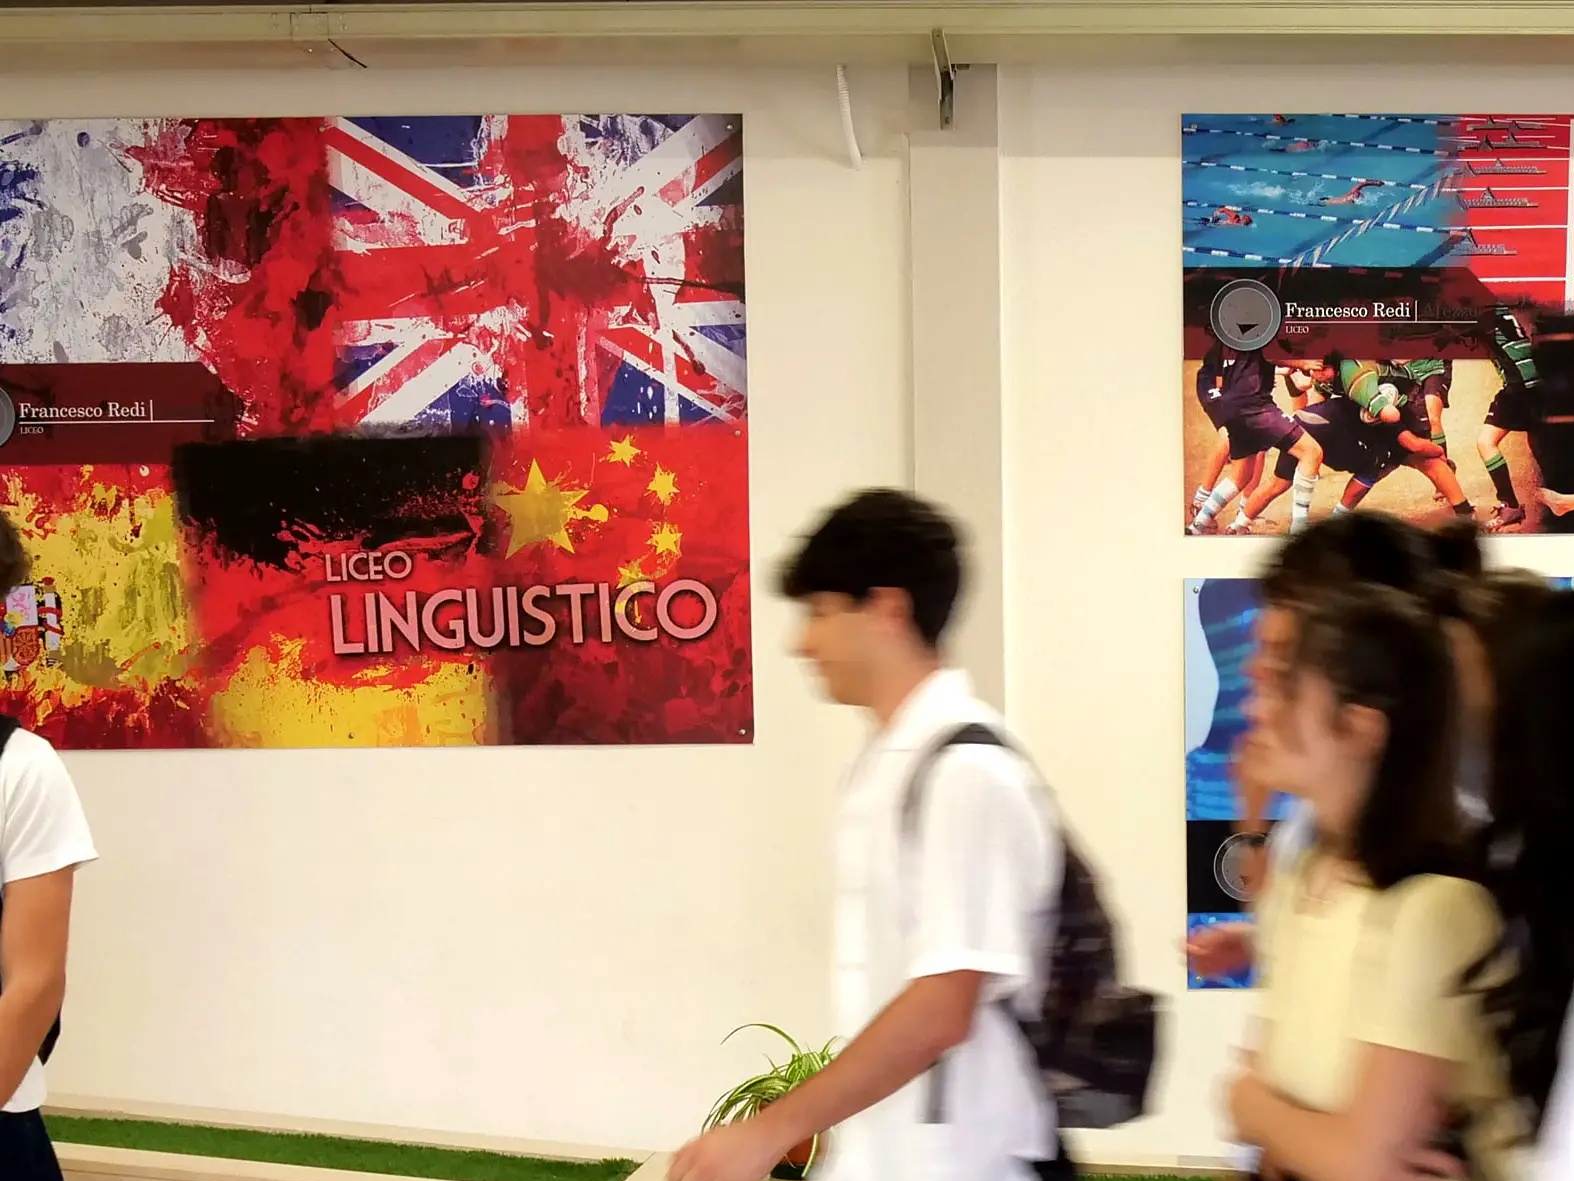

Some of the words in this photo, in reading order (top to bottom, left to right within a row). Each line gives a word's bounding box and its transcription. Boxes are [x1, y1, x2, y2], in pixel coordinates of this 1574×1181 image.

[1285, 302, 1368, 318] Francesco
[1373, 301, 1411, 318] Redi
[1285, 326, 1309, 334] LICEO
[19, 403, 103, 419] Francesco
[107, 401, 146, 418] Redi
[20, 426, 44, 435] LICEO
[325, 551, 413, 583] LICEO
[330, 578, 718, 655] LINGUISTICO
